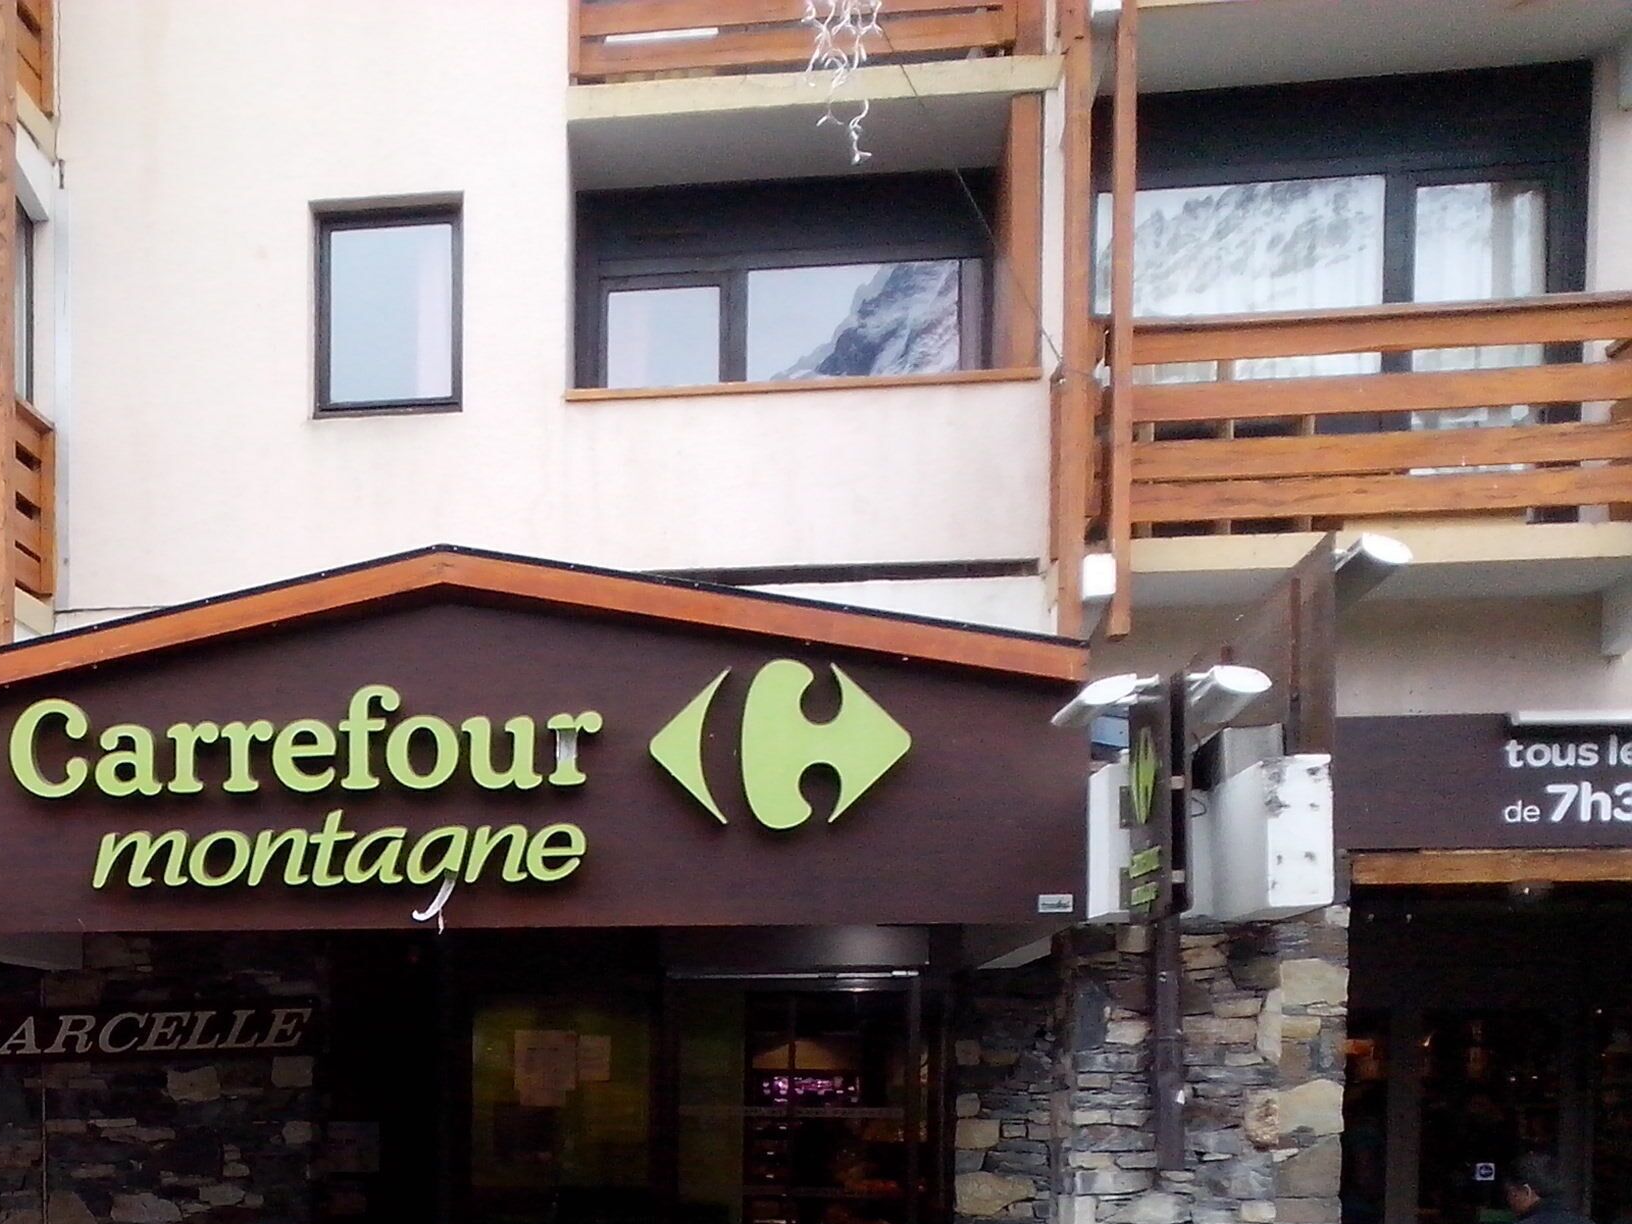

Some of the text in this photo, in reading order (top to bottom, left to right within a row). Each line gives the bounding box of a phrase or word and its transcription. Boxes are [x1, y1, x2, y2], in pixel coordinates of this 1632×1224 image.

[9, 684, 603, 798] Carrefour
[1505, 739, 1599, 768] tous
[1504, 781, 1632, 823] de 7h3
[91, 808, 586, 922] montagne
